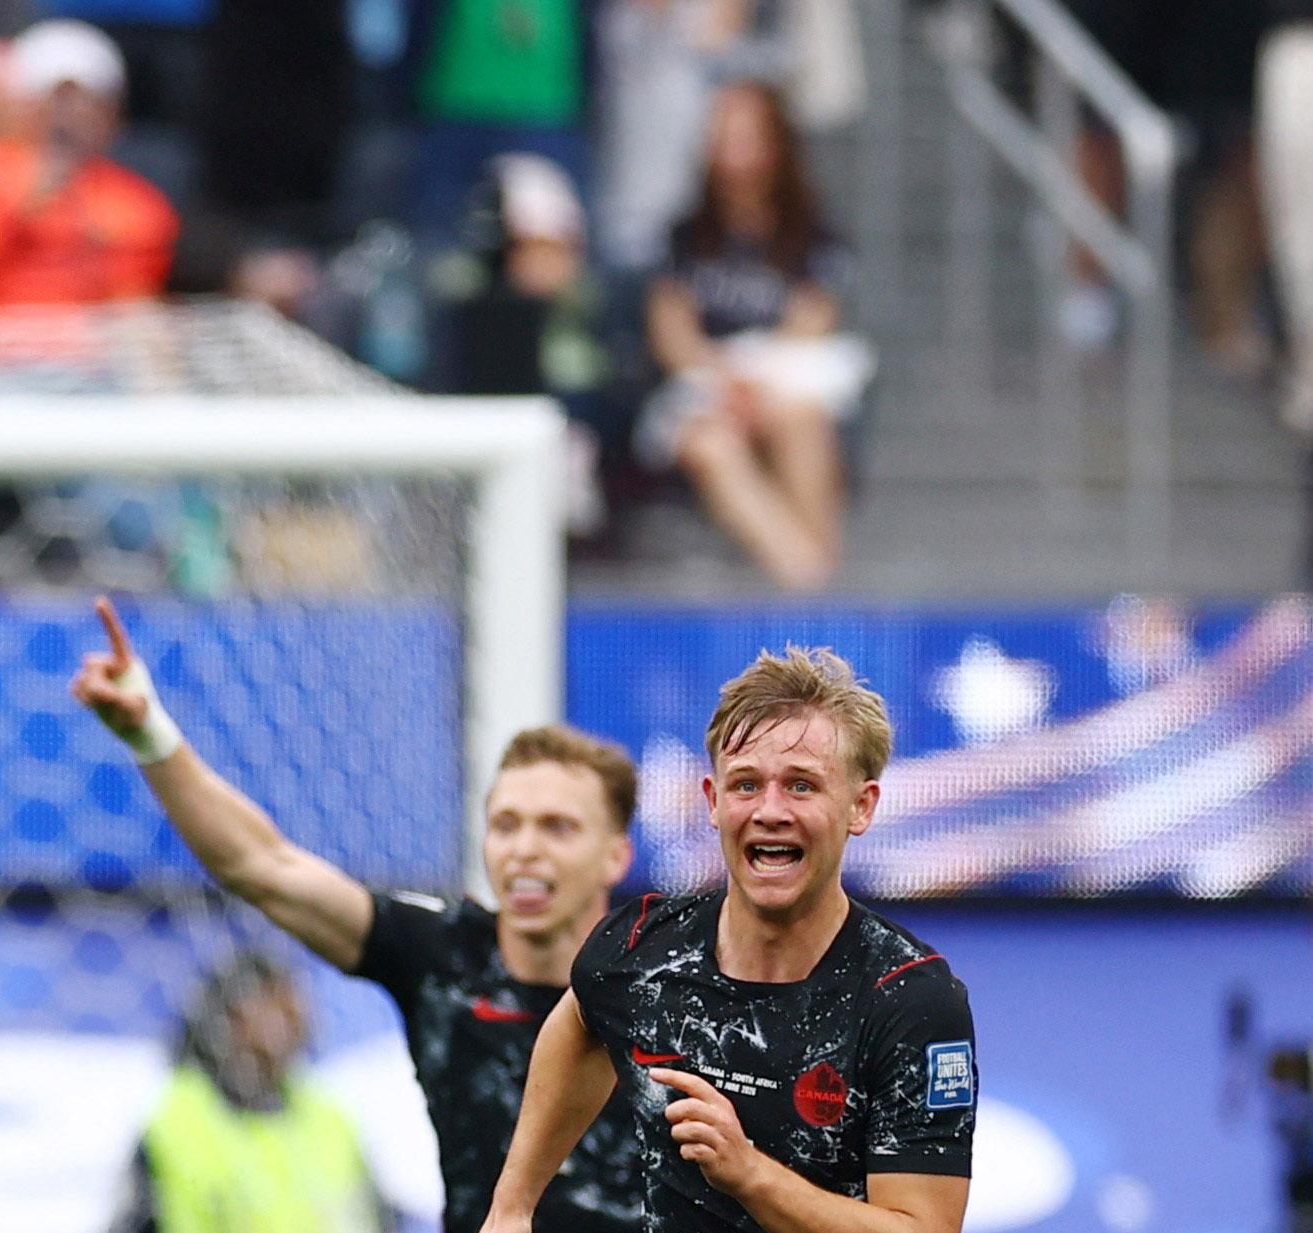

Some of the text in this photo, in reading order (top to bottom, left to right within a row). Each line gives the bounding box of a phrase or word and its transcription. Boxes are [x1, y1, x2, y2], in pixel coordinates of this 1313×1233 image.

[698, 1064, 725, 1079] CANADA
[731, 1072, 755, 1085] SOUTH
[755, 1077, 778, 1090] AFRICA
[937, 1062, 969, 1079] UNITES
[796, 1089, 844, 1105] CANADA
